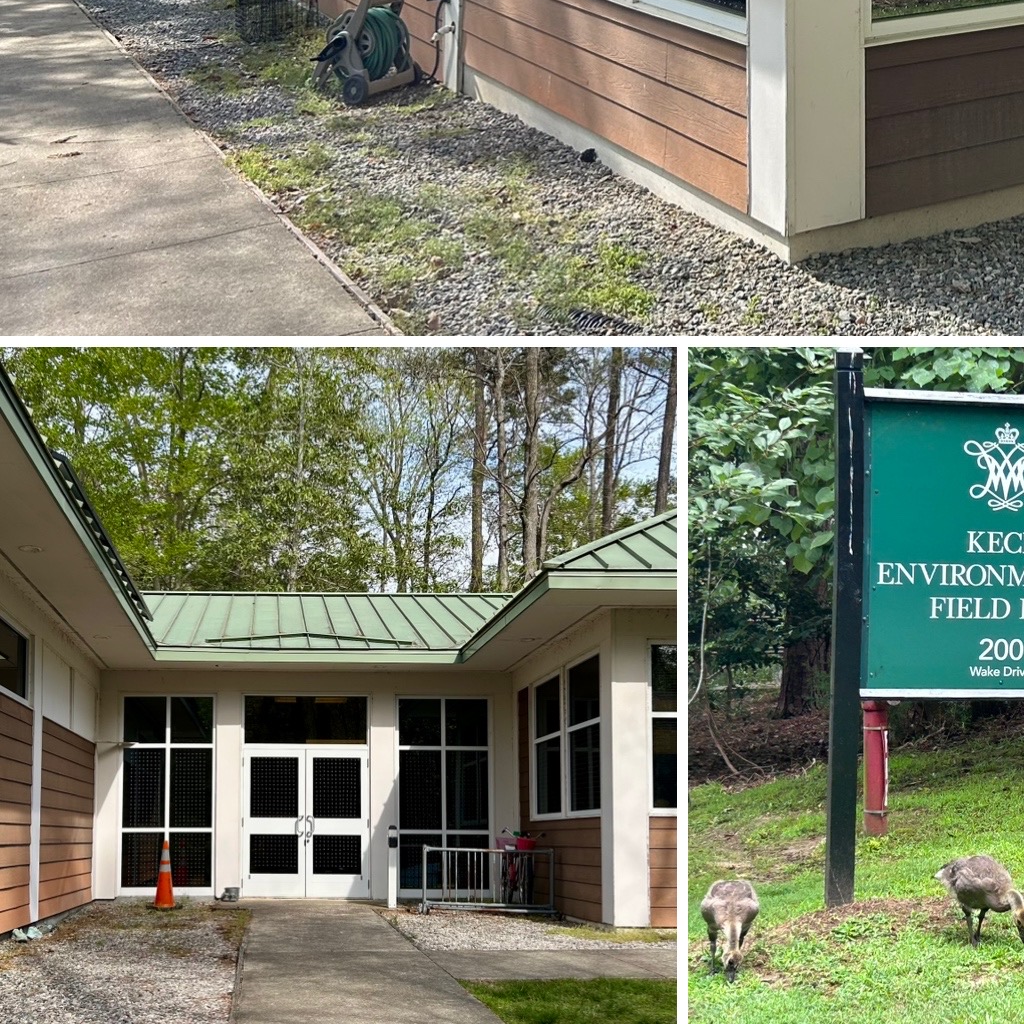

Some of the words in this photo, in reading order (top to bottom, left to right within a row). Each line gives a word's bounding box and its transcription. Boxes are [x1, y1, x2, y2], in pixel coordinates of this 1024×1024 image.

[929, 596, 1011, 620] FIELD
[978, 638, 1024, 661] 200
[969, 665, 1000, 677] Wake
